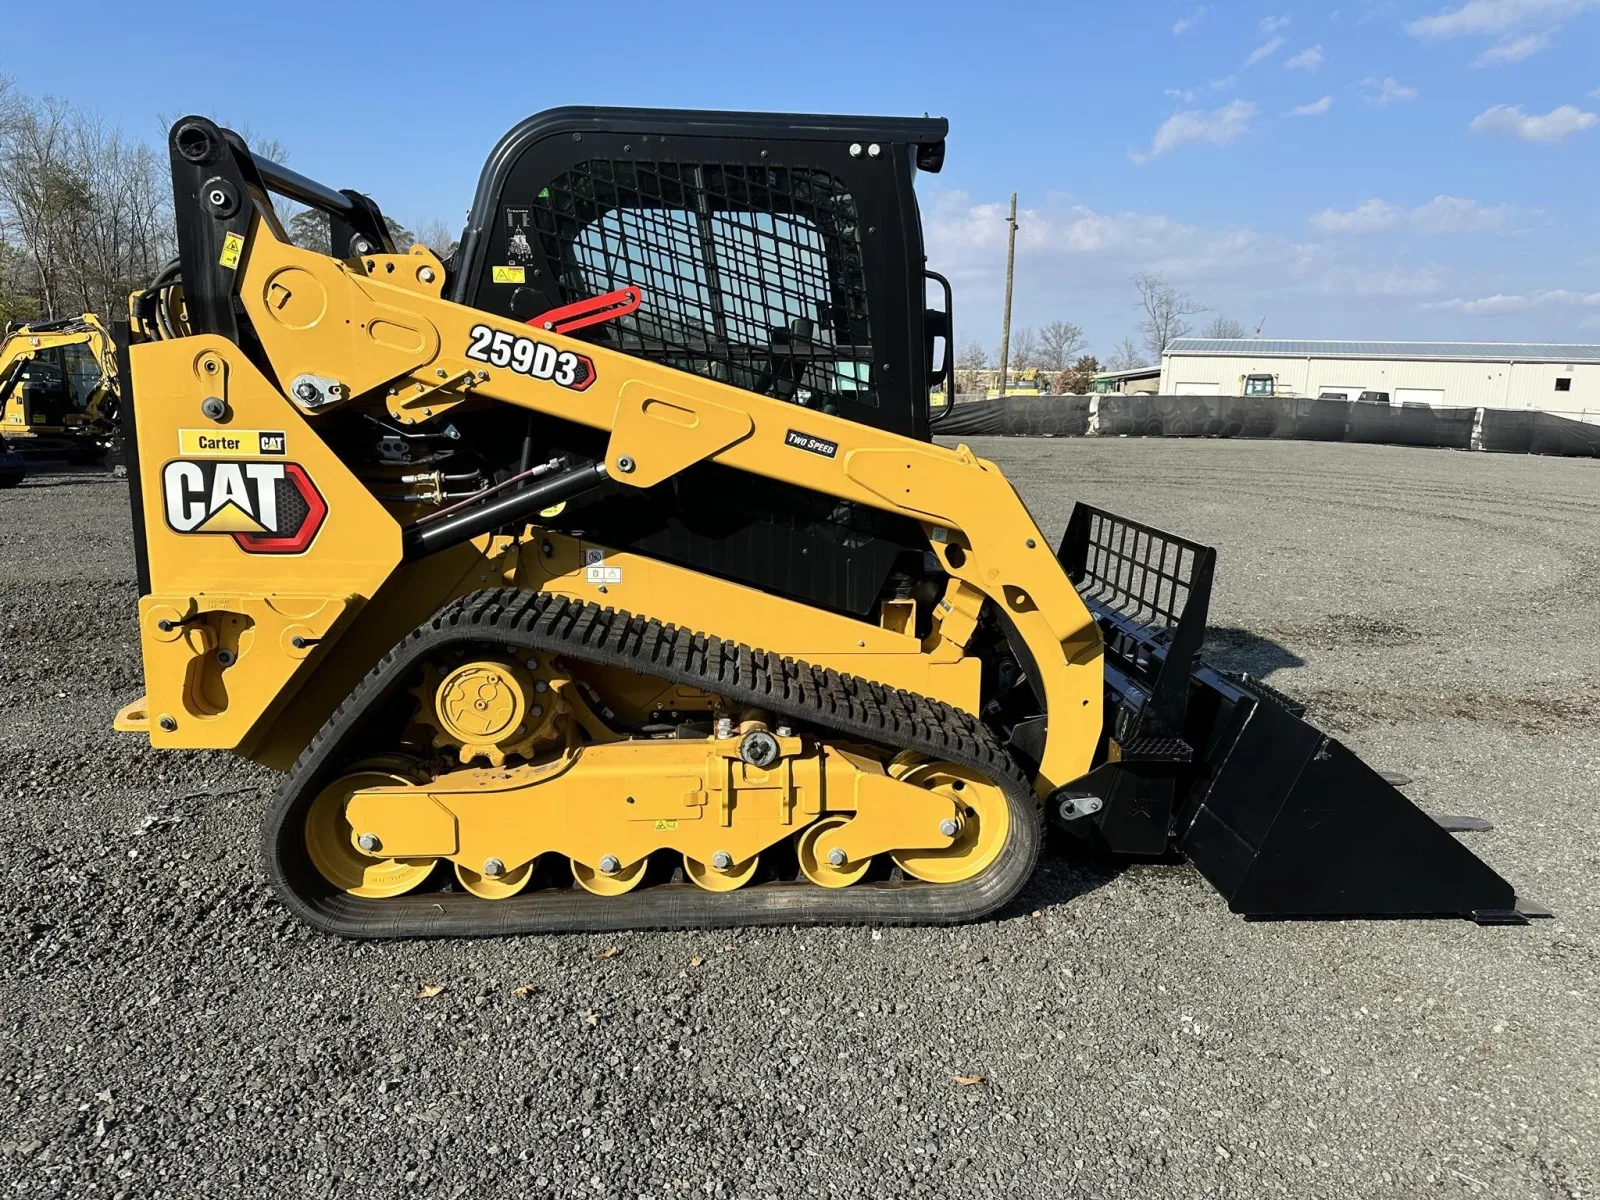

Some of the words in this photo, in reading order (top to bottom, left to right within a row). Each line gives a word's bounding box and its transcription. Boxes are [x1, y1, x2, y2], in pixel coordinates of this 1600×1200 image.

[466, 324, 578, 386] 259D3
[198, 436, 240, 450] Carter
[260, 437, 283, 451] CAT
[164, 462, 285, 531] CAT
